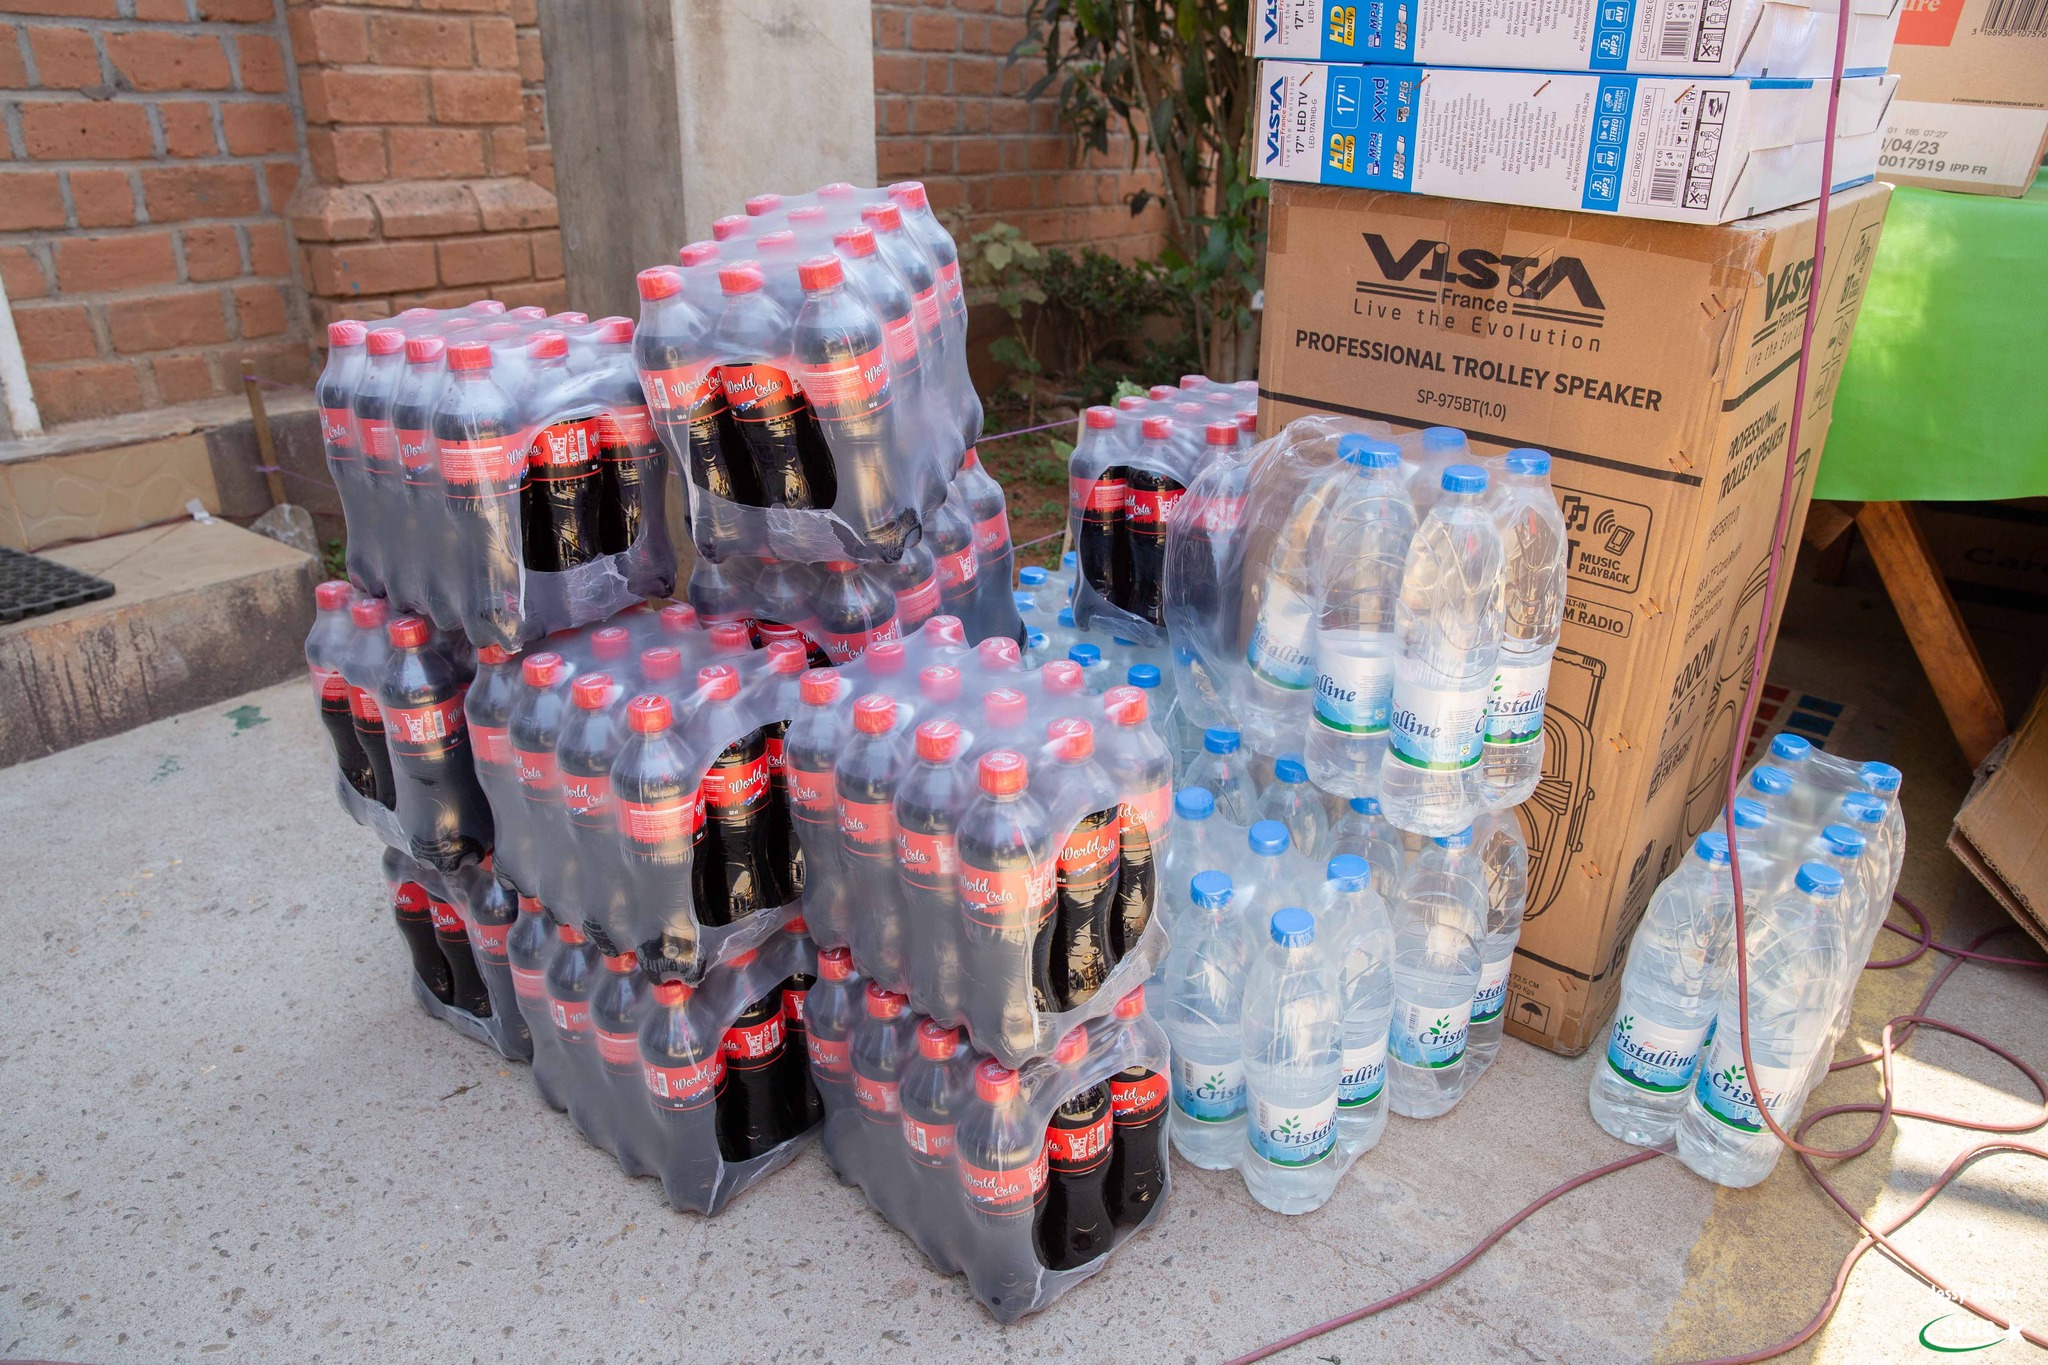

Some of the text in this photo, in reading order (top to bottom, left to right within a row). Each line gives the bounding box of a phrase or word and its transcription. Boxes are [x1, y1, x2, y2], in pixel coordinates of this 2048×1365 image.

[1615, 6, 1624, 22] AVI
[1329, 6, 1344, 43] HD
[1345, 11, 1354, 40] ready
[1640, 6, 1653, 53] Color: ROSE
[1983, 29, 2013, 37] 168930
[2017, 30, 2047, 38] 107576
[1610, 35, 1619, 55] MP3
[1298, 92, 1308, 107] TV
[1398, 81, 1408, 105] JPEG
[1297, 110, 1306, 132] LED
[1609, 119, 1619, 141] STEREO
[1924, 130, 1948, 138] 07:27
[1329, 133, 1344, 169] HD
[1345, 139, 1354, 167] ready
[1368, 133, 1377, 158] MP4
[1630, 95, 1652, 197] Color: ROSE GOLD SILVER
[1606, 151, 1615, 167] AVI
[1950, 163, 1969, 172] IPP
[1972, 166, 1987, 175] FR
[1601, 177, 1610, 197] MP3
[1440, 289, 1509, 315] France
[1353, 298, 1602, 352] Live the Evolution
[1295, 328, 1663, 413] PROFESSIONAL TROLLEY SPEAKER
[754, 380, 783, 397] Cola
[1416, 388, 1507, 422] SP-975BT(1.0)
[1133, 505, 1151, 516] Cola
[1580, 552, 1620, 570] MUSIC
[1578, 563, 1630, 584] PLAYBACK
[1566, 599, 1587, 610] ILT-IN
[1563, 607, 1623, 633] M RADIO
[1669, 628, 1721, 711] 5000W
[522, 768, 541, 779] Cola
[728, 765, 763, 795] World
[797, 787, 817, 800] Cola
[844, 816, 865, 831] Cola
[905, 849, 927, 863] Cola
[1060, 838, 1100, 863] World
[986, 889, 1014, 905] Cola
[438, 915, 454, 925] Cola
[481, 936, 499, 947] Cola
[1513, 974, 1539, 989] 73.5 CM
[1612, 1022, 1696, 1068] Cristalline
[819, 1052, 838, 1063] Cola
[672, 1064, 709, 1091] World
[1135, 1090, 1157, 1105] Cola
[994, 1183, 1019, 1198] Cola
